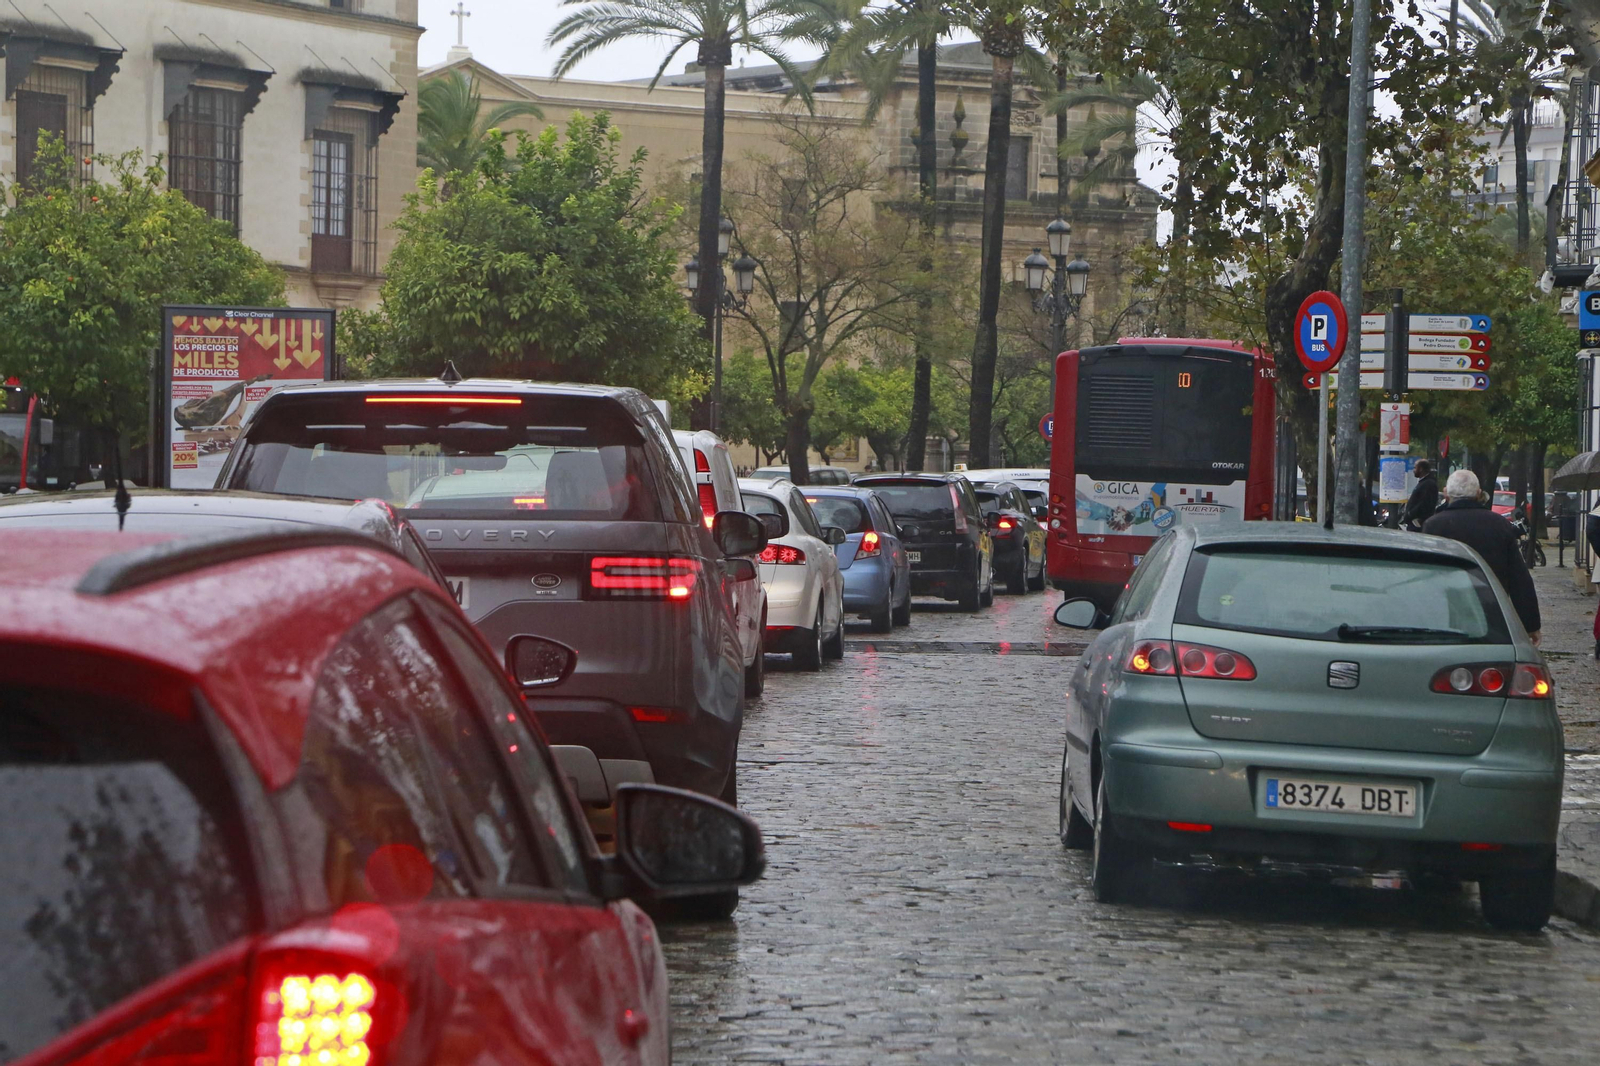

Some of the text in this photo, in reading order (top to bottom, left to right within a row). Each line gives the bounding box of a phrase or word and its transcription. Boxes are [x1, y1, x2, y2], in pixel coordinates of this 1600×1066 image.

[1314, 318, 1324, 337] P
[174, 351, 239, 368] MILES
[174, 453, 195, 462] 20%
[1108, 482, 1139, 494] GICA
[1282, 783, 1345, 808] 8374
[1362, 788, 1408, 812] DBT
